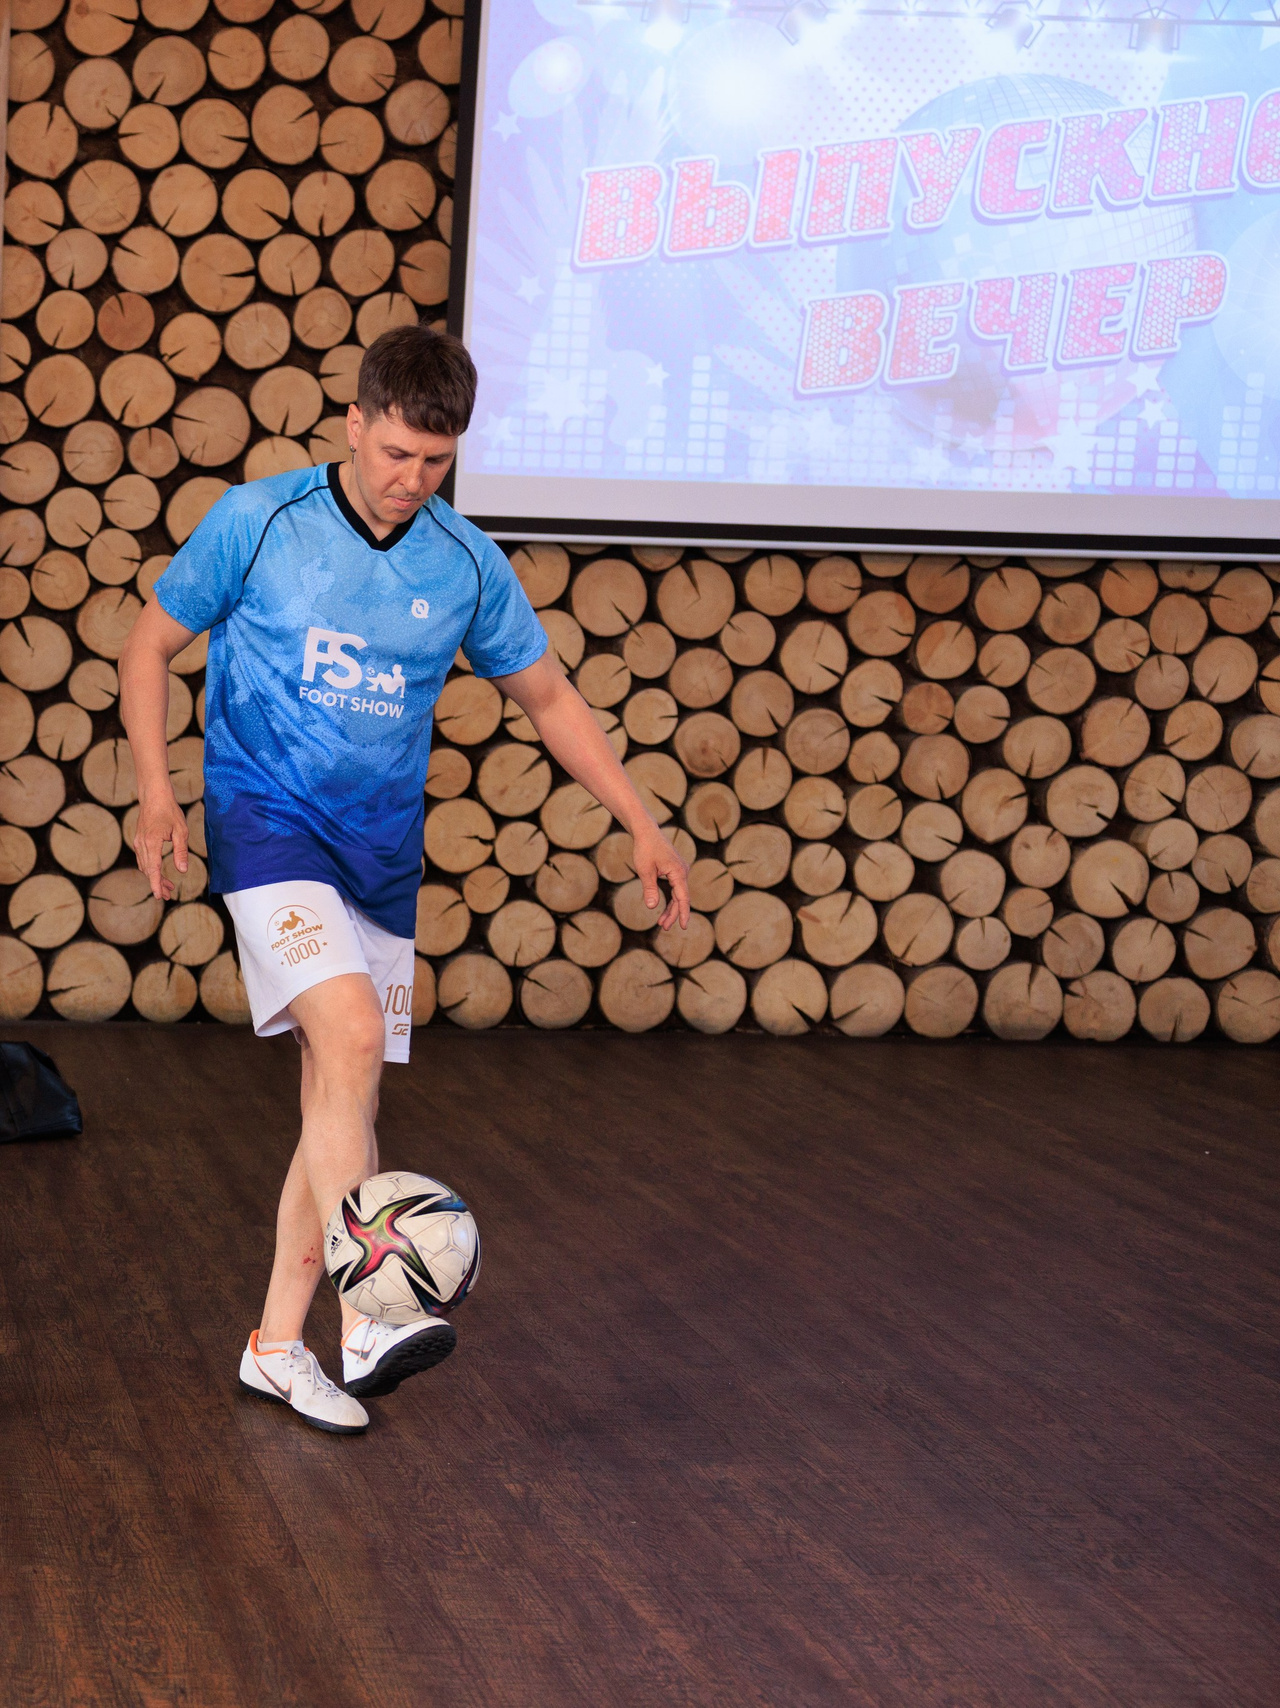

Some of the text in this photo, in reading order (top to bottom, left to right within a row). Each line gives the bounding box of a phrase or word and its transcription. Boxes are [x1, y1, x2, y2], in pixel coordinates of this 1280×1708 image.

[796, 253, 1228, 394] ВЕЧЕР
[301, 626, 368, 690] FS
[299, 686, 404, 719] FOOT SHOW
[271, 923, 323, 951] FOOT SHOW
[283, 938, 321, 967] 1000
